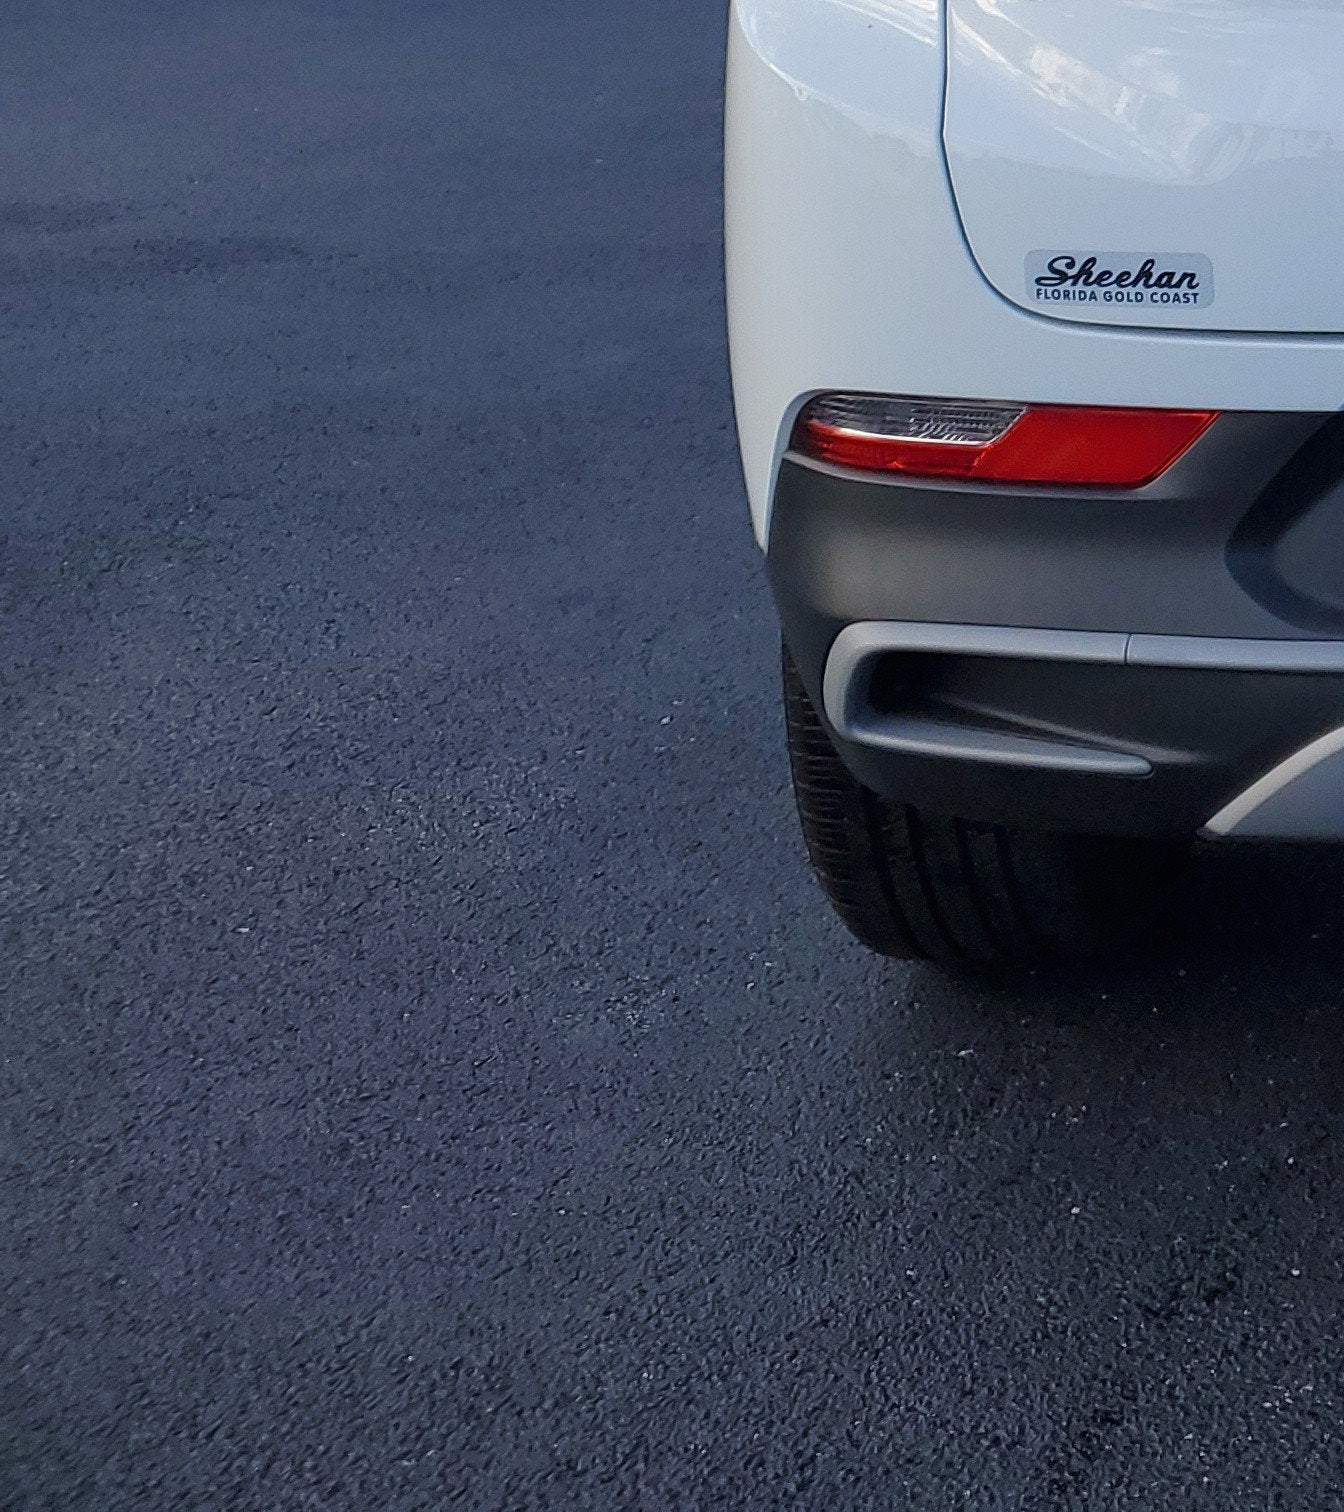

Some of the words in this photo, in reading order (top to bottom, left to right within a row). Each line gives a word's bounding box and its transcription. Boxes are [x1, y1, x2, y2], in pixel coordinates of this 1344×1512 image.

[1035, 255, 1200, 289] Sheehan
[1036, 288, 1098, 303] FLORIDA
[1103, 290, 1144, 304] GOLD
[1150, 291, 1199, 305] COAST
